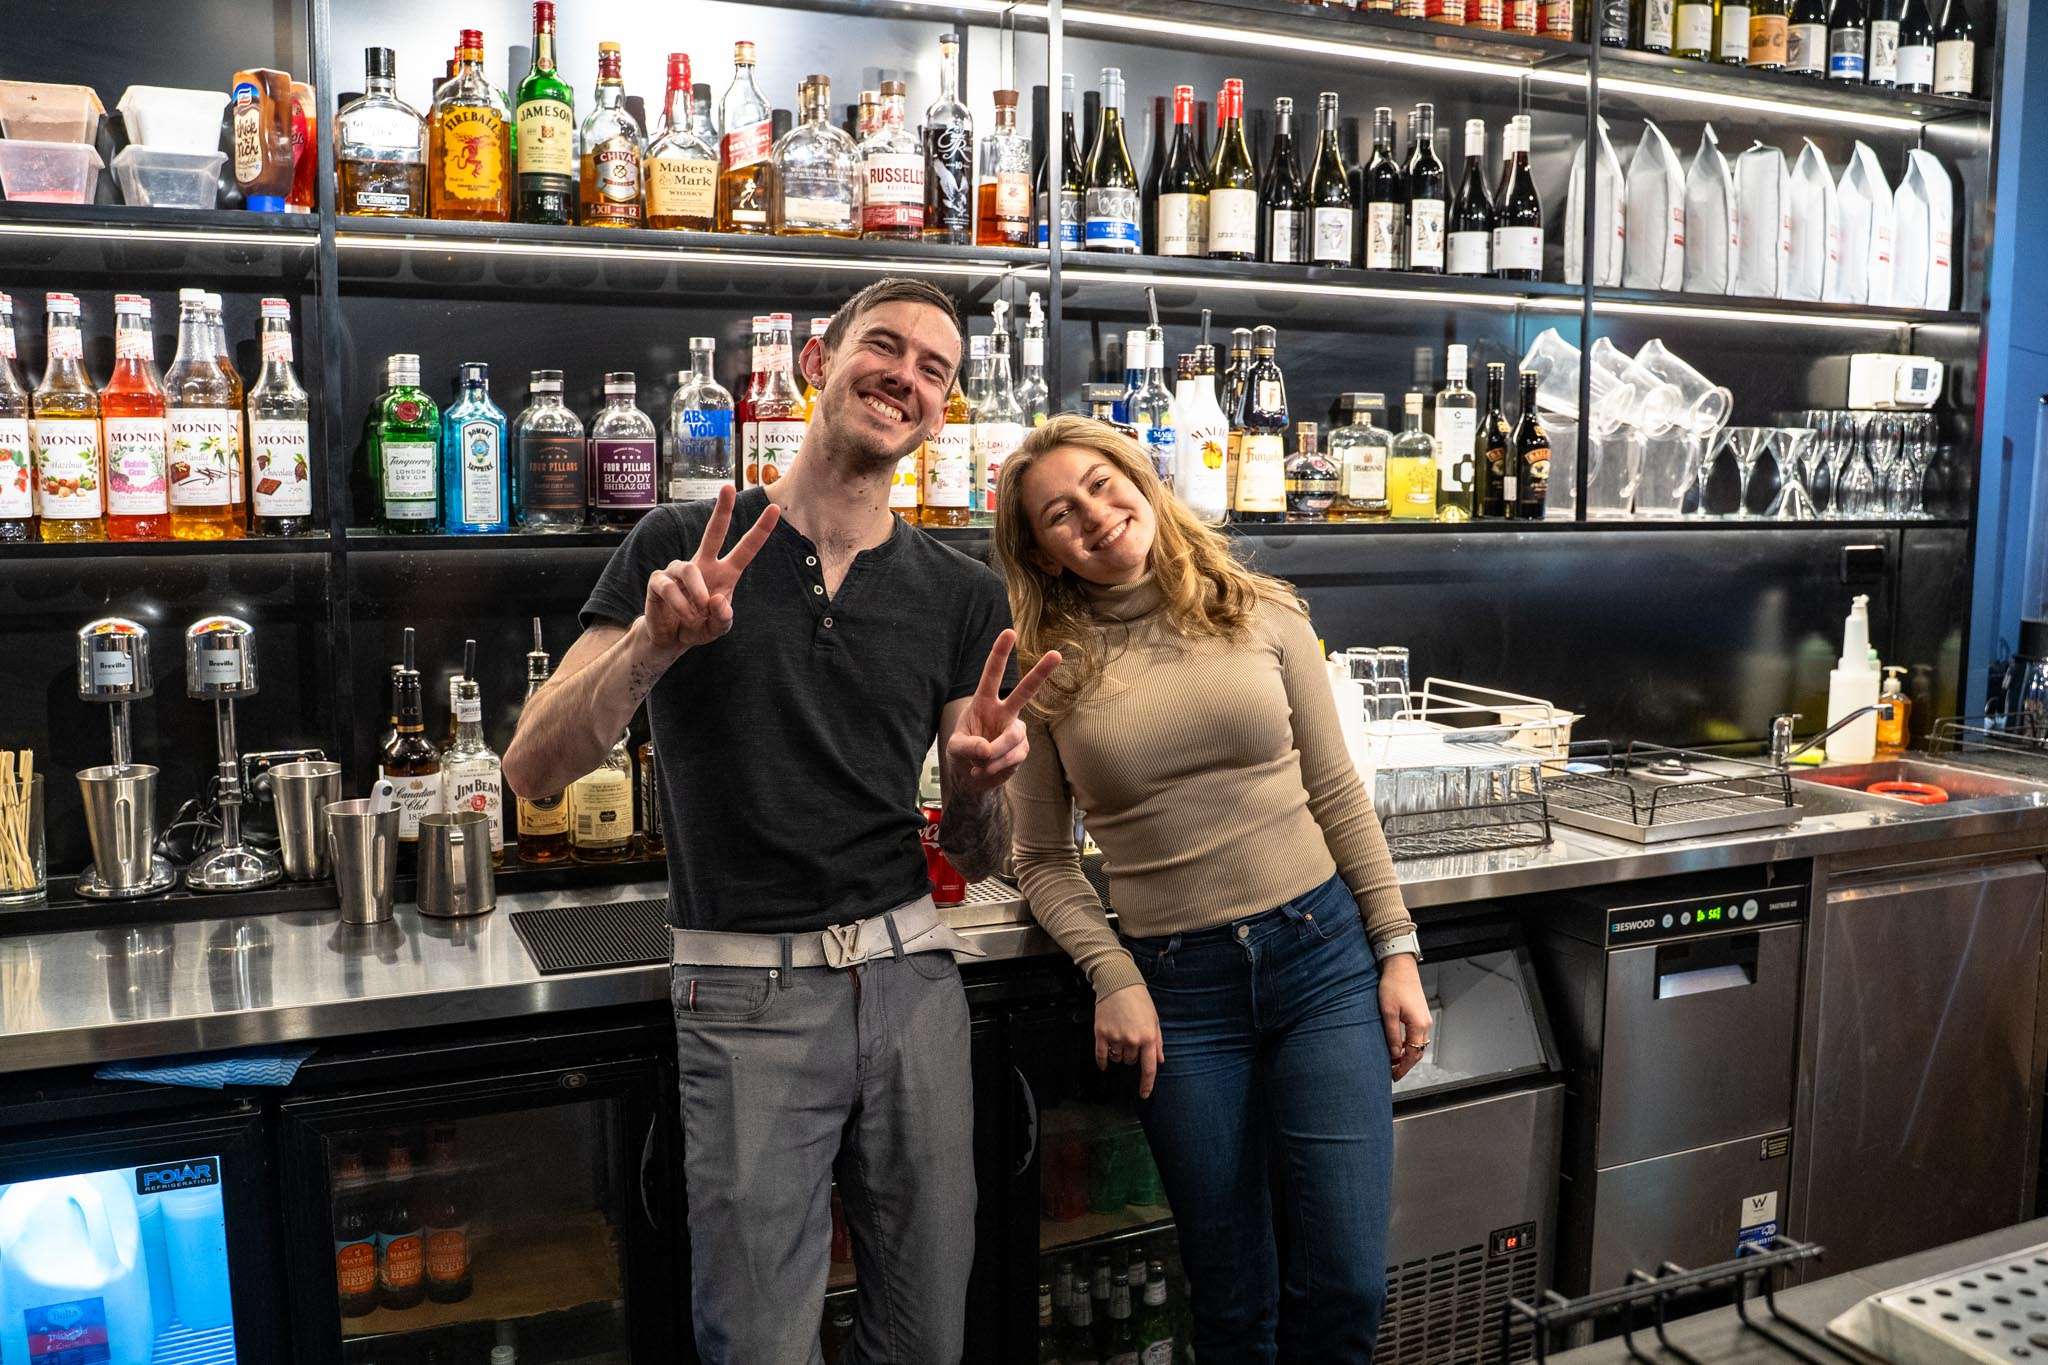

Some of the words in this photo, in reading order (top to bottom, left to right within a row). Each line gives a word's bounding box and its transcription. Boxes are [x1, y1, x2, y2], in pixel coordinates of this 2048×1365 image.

[520, 106, 571, 123] JAMESON
[445, 111, 500, 133] FIREBALL
[600, 152, 636, 164] CHIVAS
[674, 175, 712, 186] Mark
[895, 208, 908, 222] 10
[172, 423, 223, 433] MONIN
[41, 435, 93, 445] MONIN
[111, 432, 162, 442] MONIN
[258, 434, 305, 445] MONIN
[390, 455, 431, 467] Tanqueray
[603, 462, 621, 472] FOUR
[622, 462, 652, 472] PILLARS
[604, 473, 651, 483] BLOODY
[603, 483, 637, 491] SHIRAZ
[395, 785, 437, 799] Canadian
[454, 782, 474, 801] JIM
[474, 778, 500, 797] BEAM
[143, 1163, 212, 1186] POLAR
[145, 1178, 213, 1191] REFRIGERATION
